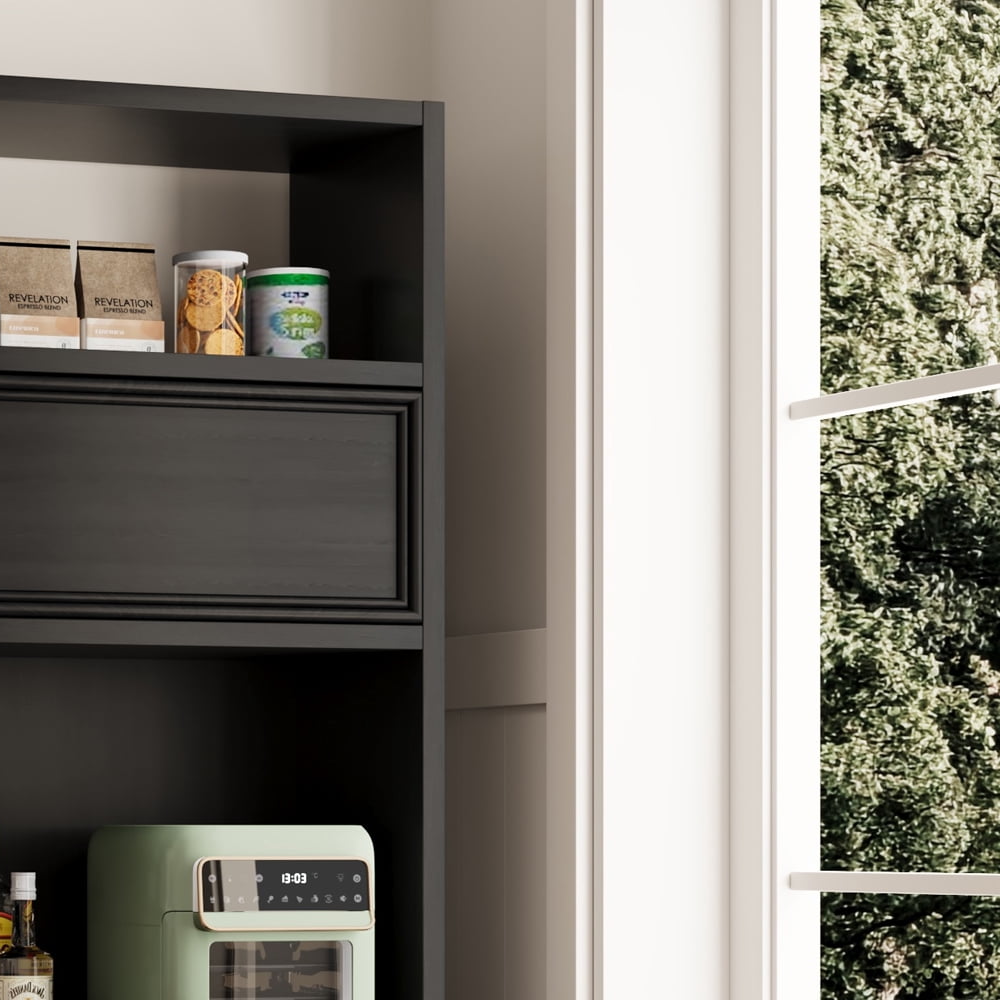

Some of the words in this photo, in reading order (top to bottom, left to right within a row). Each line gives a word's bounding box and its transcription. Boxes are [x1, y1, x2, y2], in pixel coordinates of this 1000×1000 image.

[8, 293, 68, 304] REVELATION
[94, 297, 153, 308] REVELATION
[281, 872, 307, 884] 13:03
